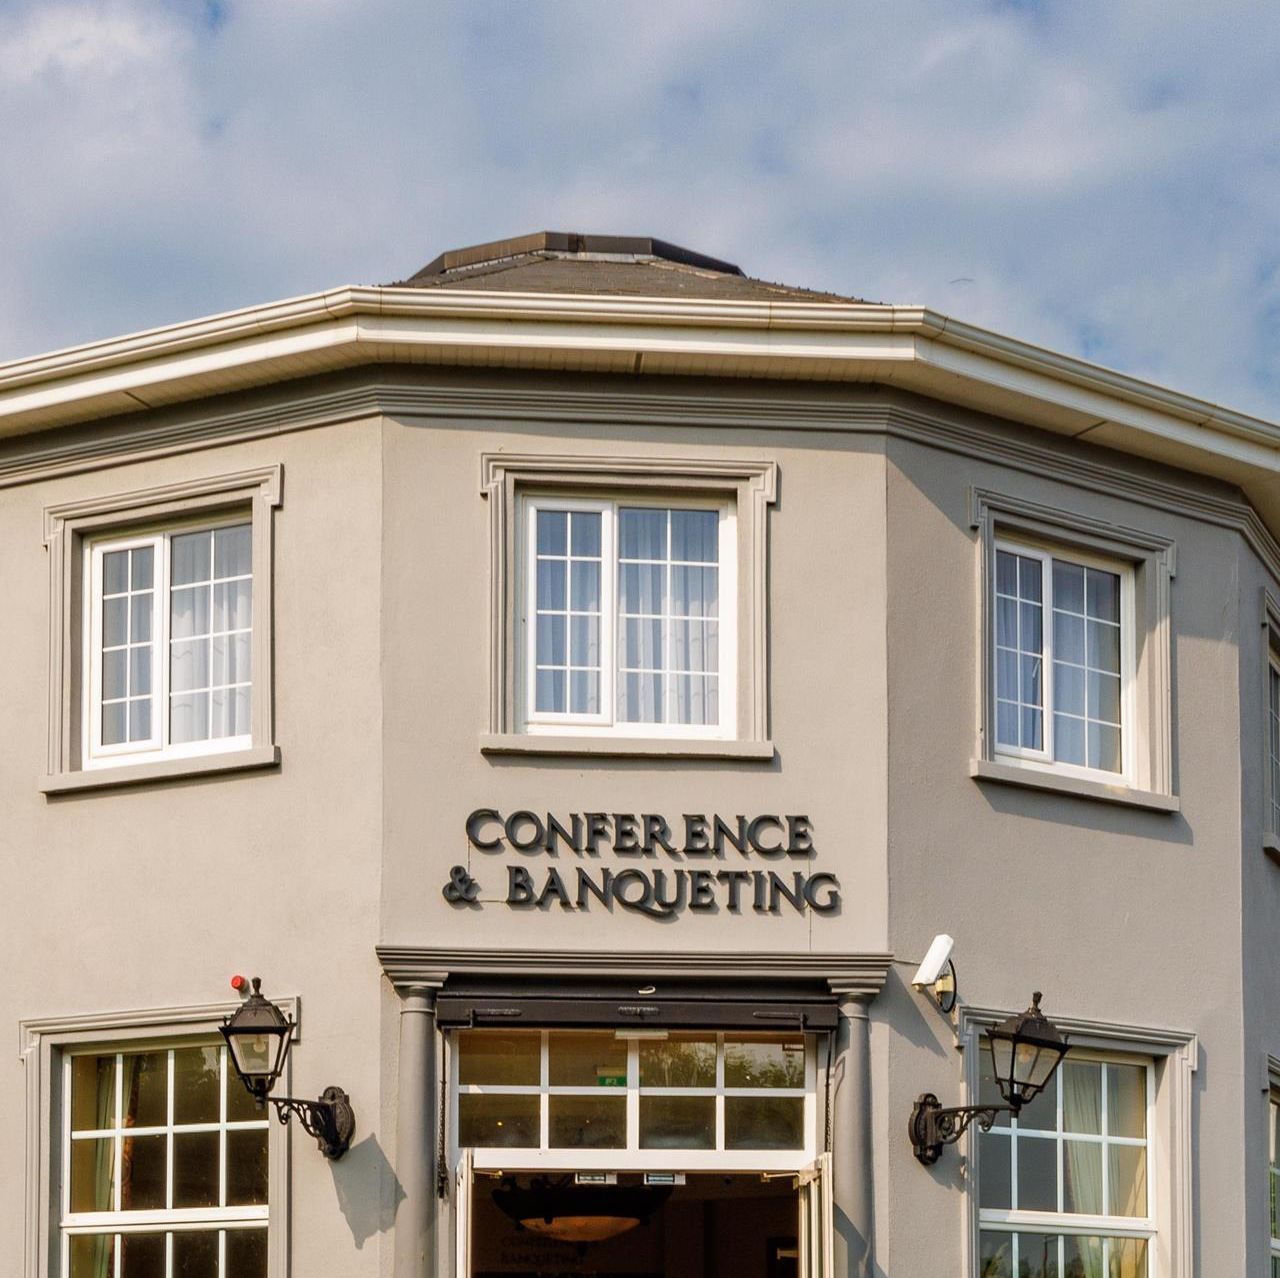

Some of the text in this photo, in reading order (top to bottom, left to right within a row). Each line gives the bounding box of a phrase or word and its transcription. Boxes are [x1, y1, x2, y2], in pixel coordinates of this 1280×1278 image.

[466, 808, 814, 855] CONFERENCE
[442, 865, 839, 918] & BANQUETING
